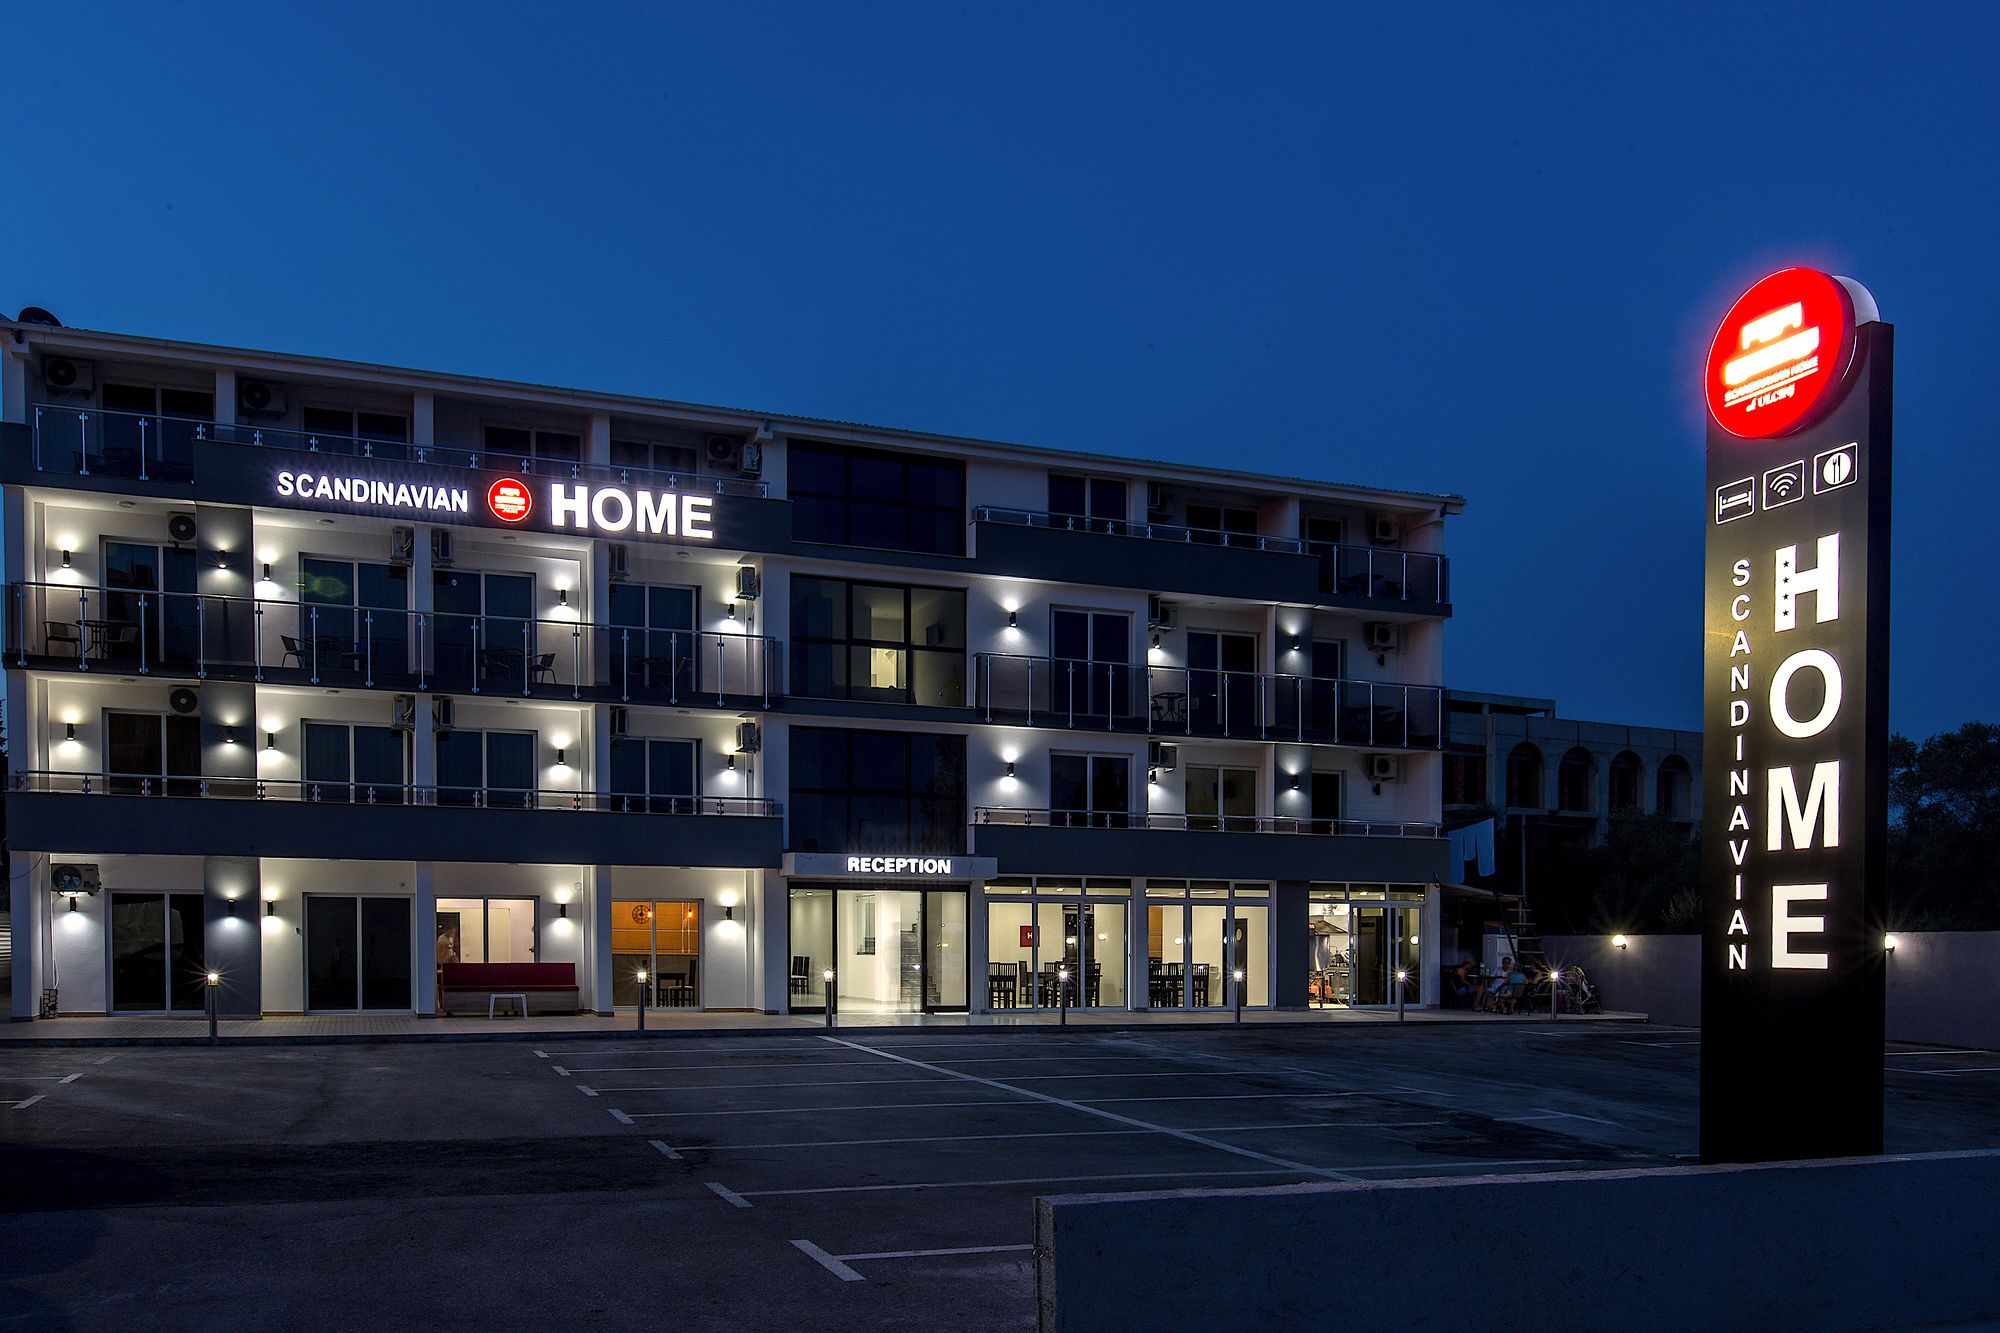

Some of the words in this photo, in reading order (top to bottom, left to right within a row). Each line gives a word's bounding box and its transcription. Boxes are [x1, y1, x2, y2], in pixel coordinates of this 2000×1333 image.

[277, 471, 469, 513] SCANDINAVIAN
[549, 483, 714, 538] HOME
[847, 856, 951, 874] RECEPTION
[1728, 558, 1752, 971] SCANDINAVIAN
[1767, 532, 1843, 970] HOME
